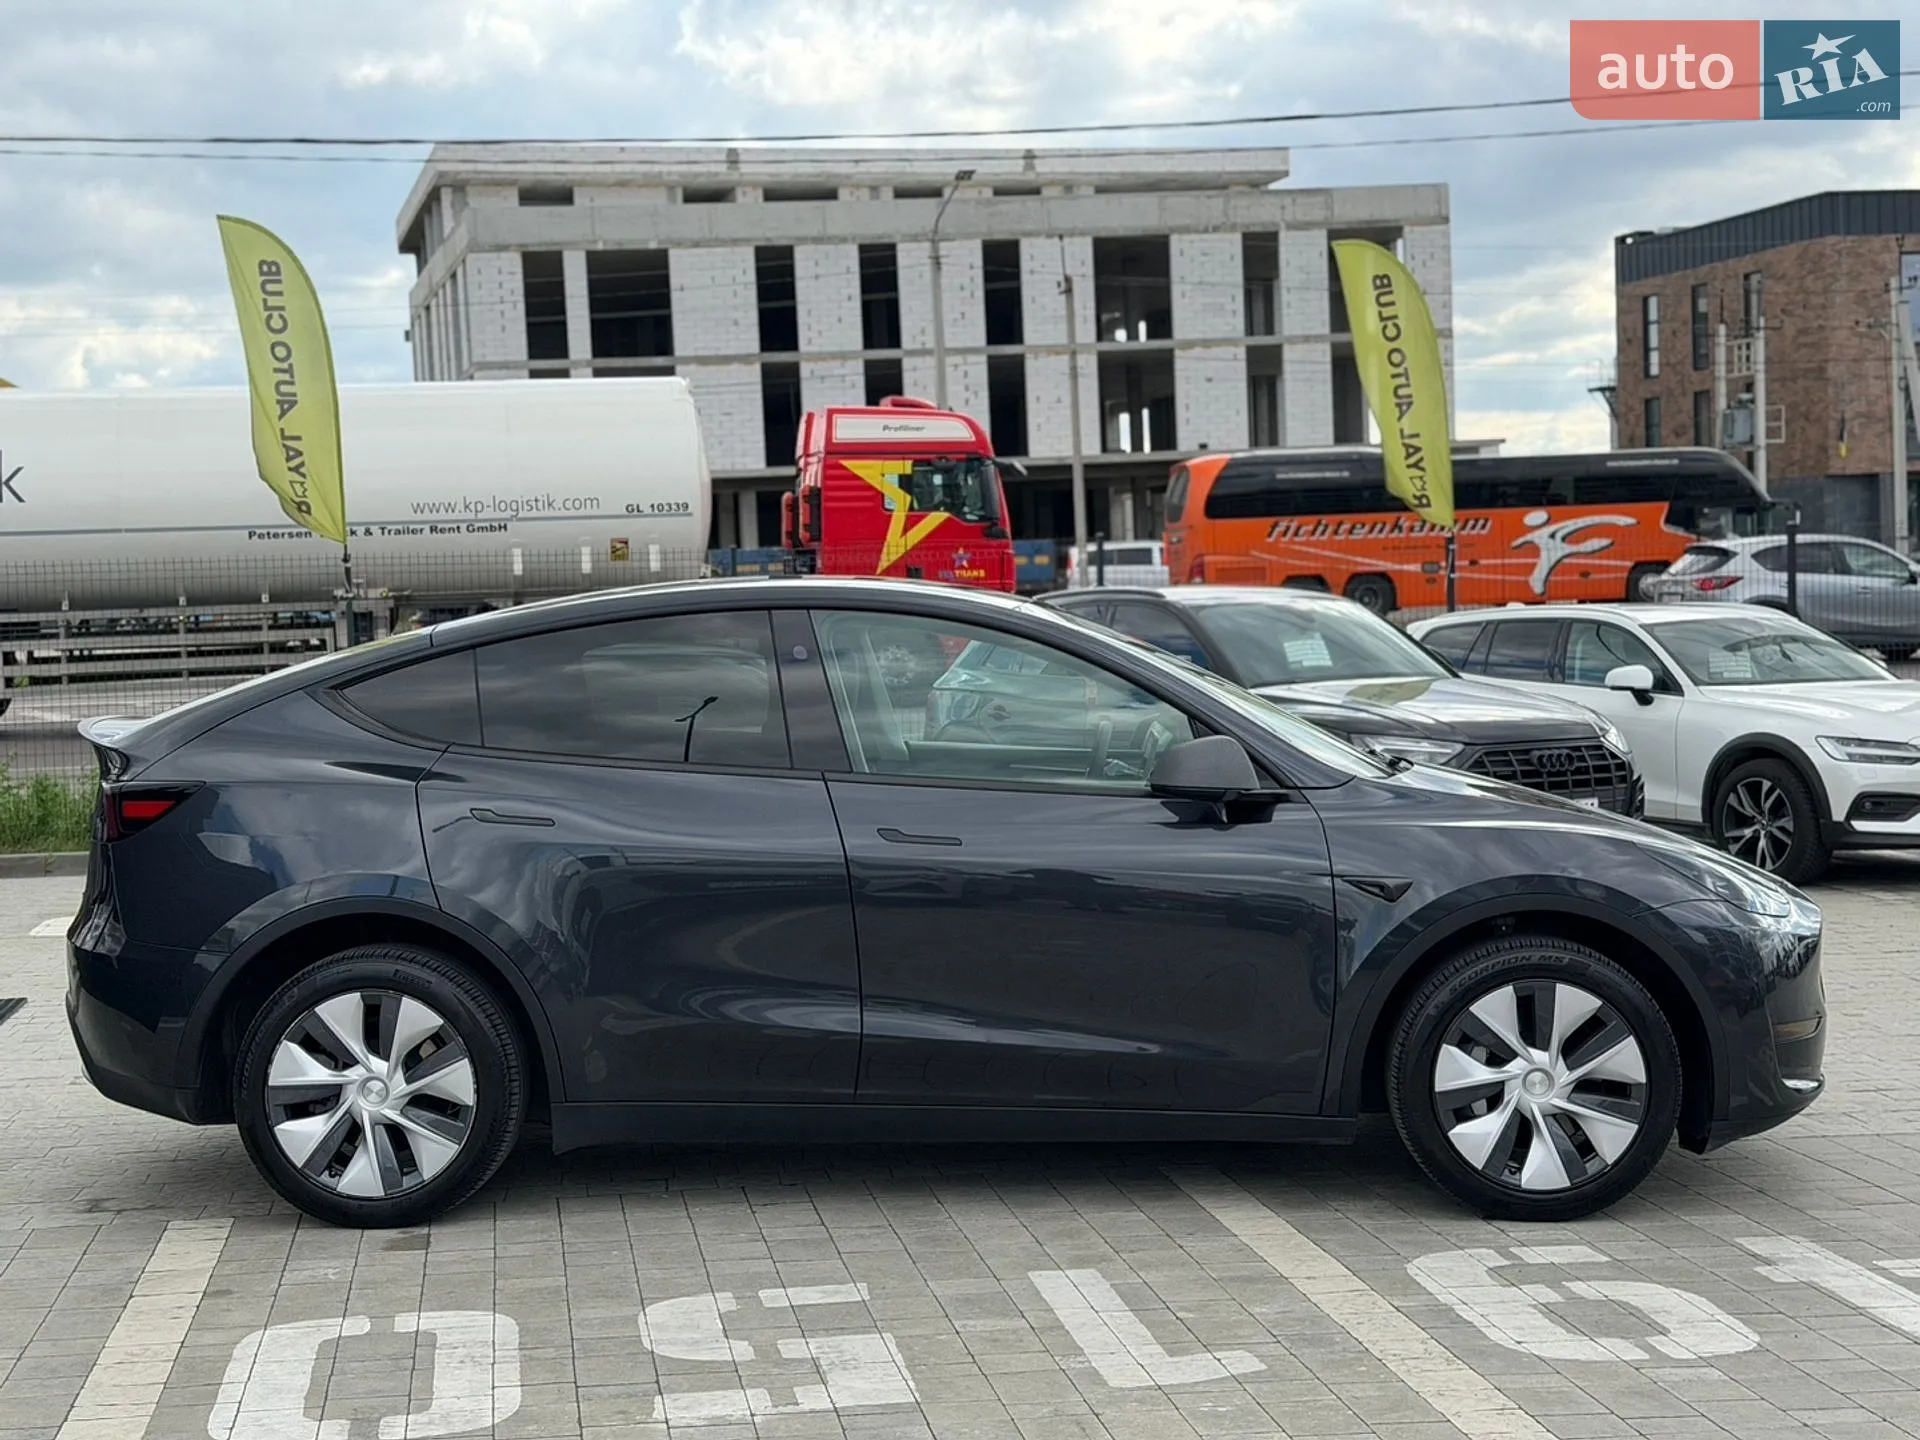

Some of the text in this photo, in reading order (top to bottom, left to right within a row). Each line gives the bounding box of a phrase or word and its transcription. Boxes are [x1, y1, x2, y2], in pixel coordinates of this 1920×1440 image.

[411, 494, 600, 518] www.kp-logistik.com
[625, 502, 690, 514] GL 10339
[248, 530, 312, 540] Petersen
[363, 527, 374, 537] &
[379, 525, 426, 537] Trailer
[429, 525, 461, 535] Rent
[466, 523, 508, 534] GmbH
